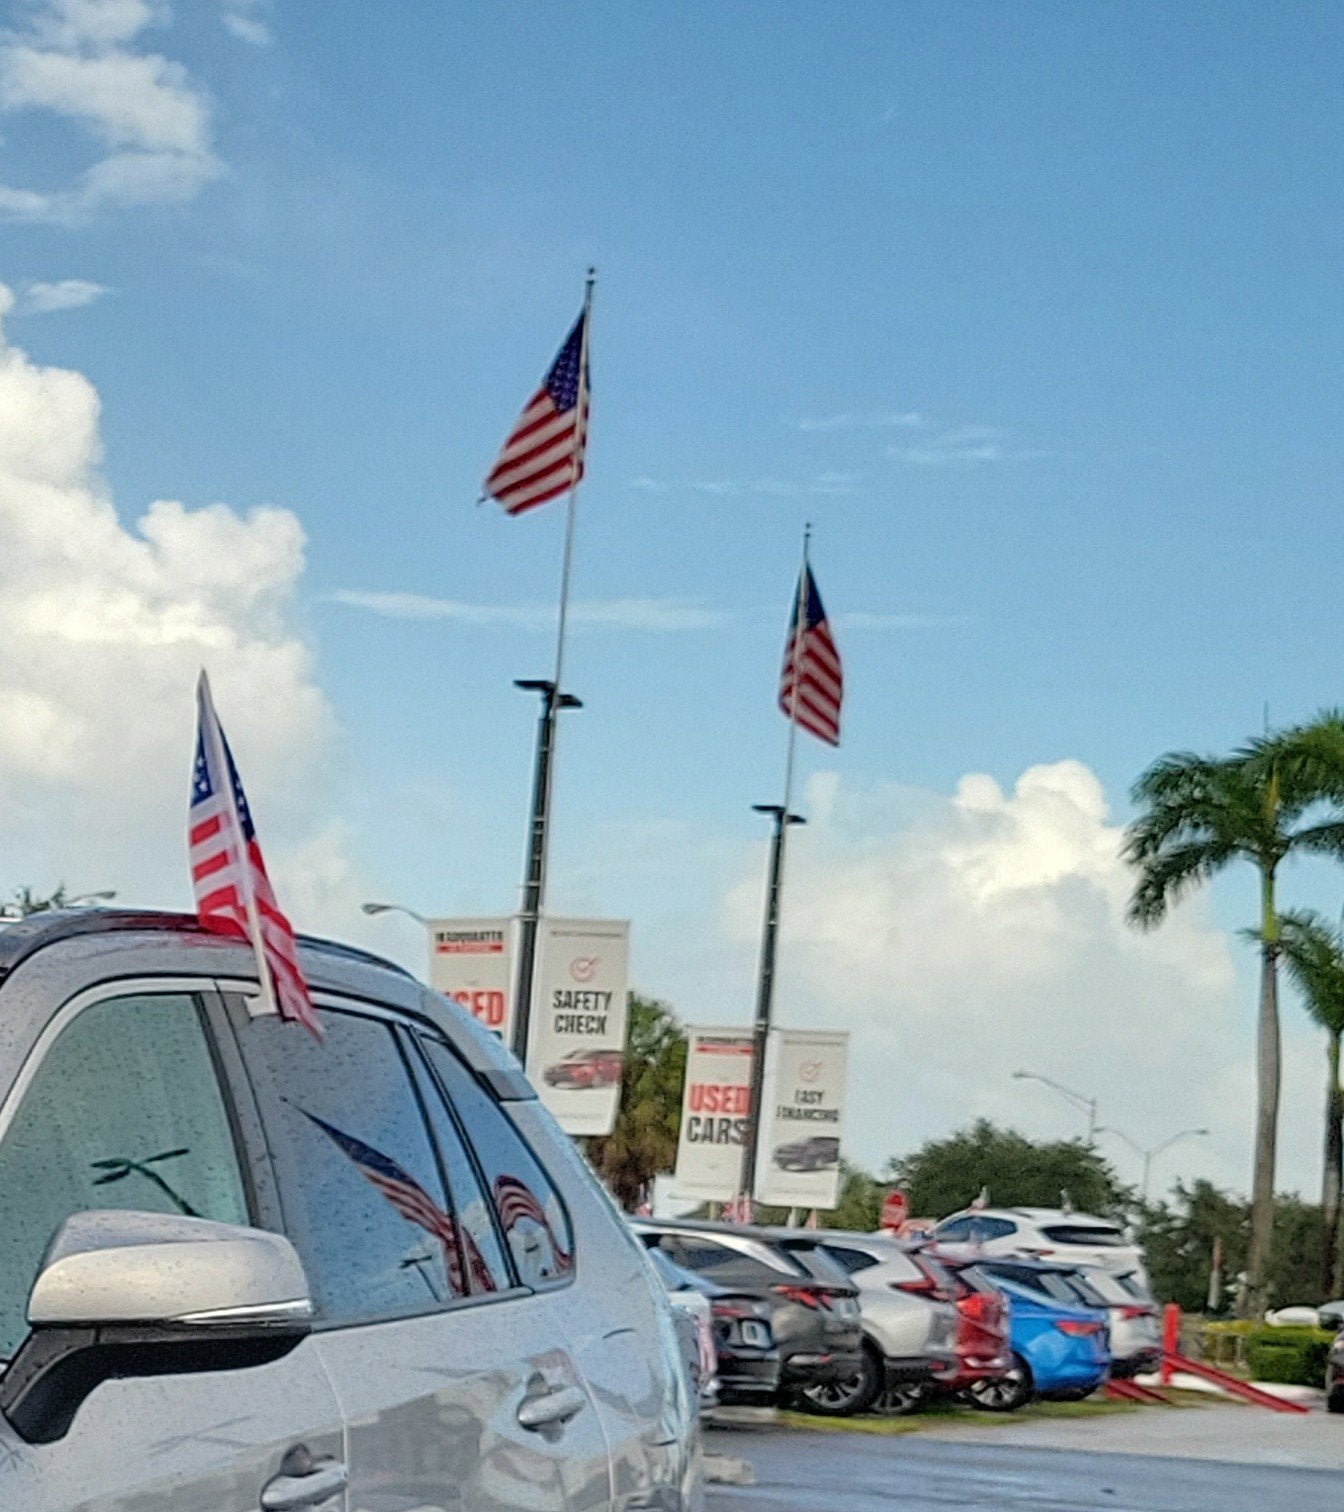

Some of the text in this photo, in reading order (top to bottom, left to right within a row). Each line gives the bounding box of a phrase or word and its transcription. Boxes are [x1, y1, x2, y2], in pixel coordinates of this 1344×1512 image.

[553, 990, 613, 1011] SAFETY
[554, 1014, 608, 1035] CHECK
[690, 1085, 751, 1115] USED
[687, 1116, 750, 1145] CARS
